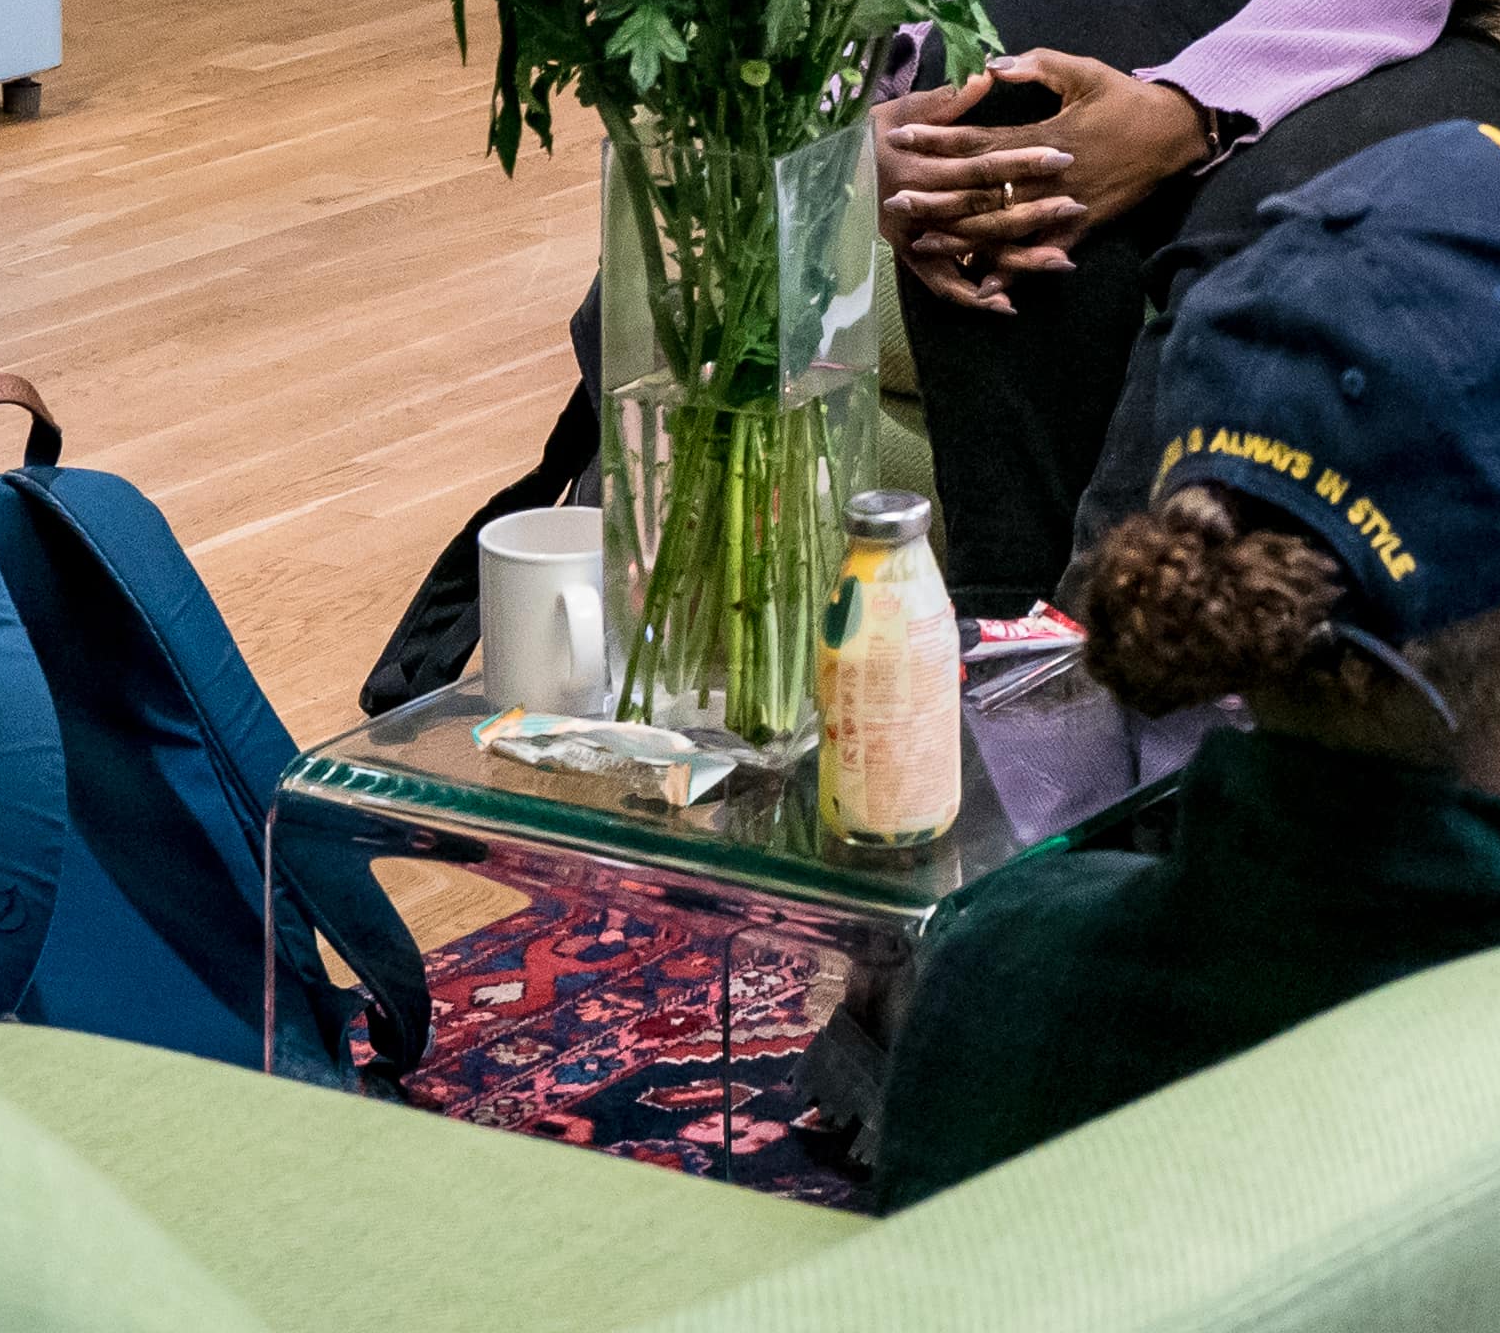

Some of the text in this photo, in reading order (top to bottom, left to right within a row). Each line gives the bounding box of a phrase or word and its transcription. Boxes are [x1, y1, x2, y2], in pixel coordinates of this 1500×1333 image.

[1208, 427, 1314, 480] ALWAYS
[1315, 468, 1349, 505] IN
[1347, 496, 1416, 582] STYLE
